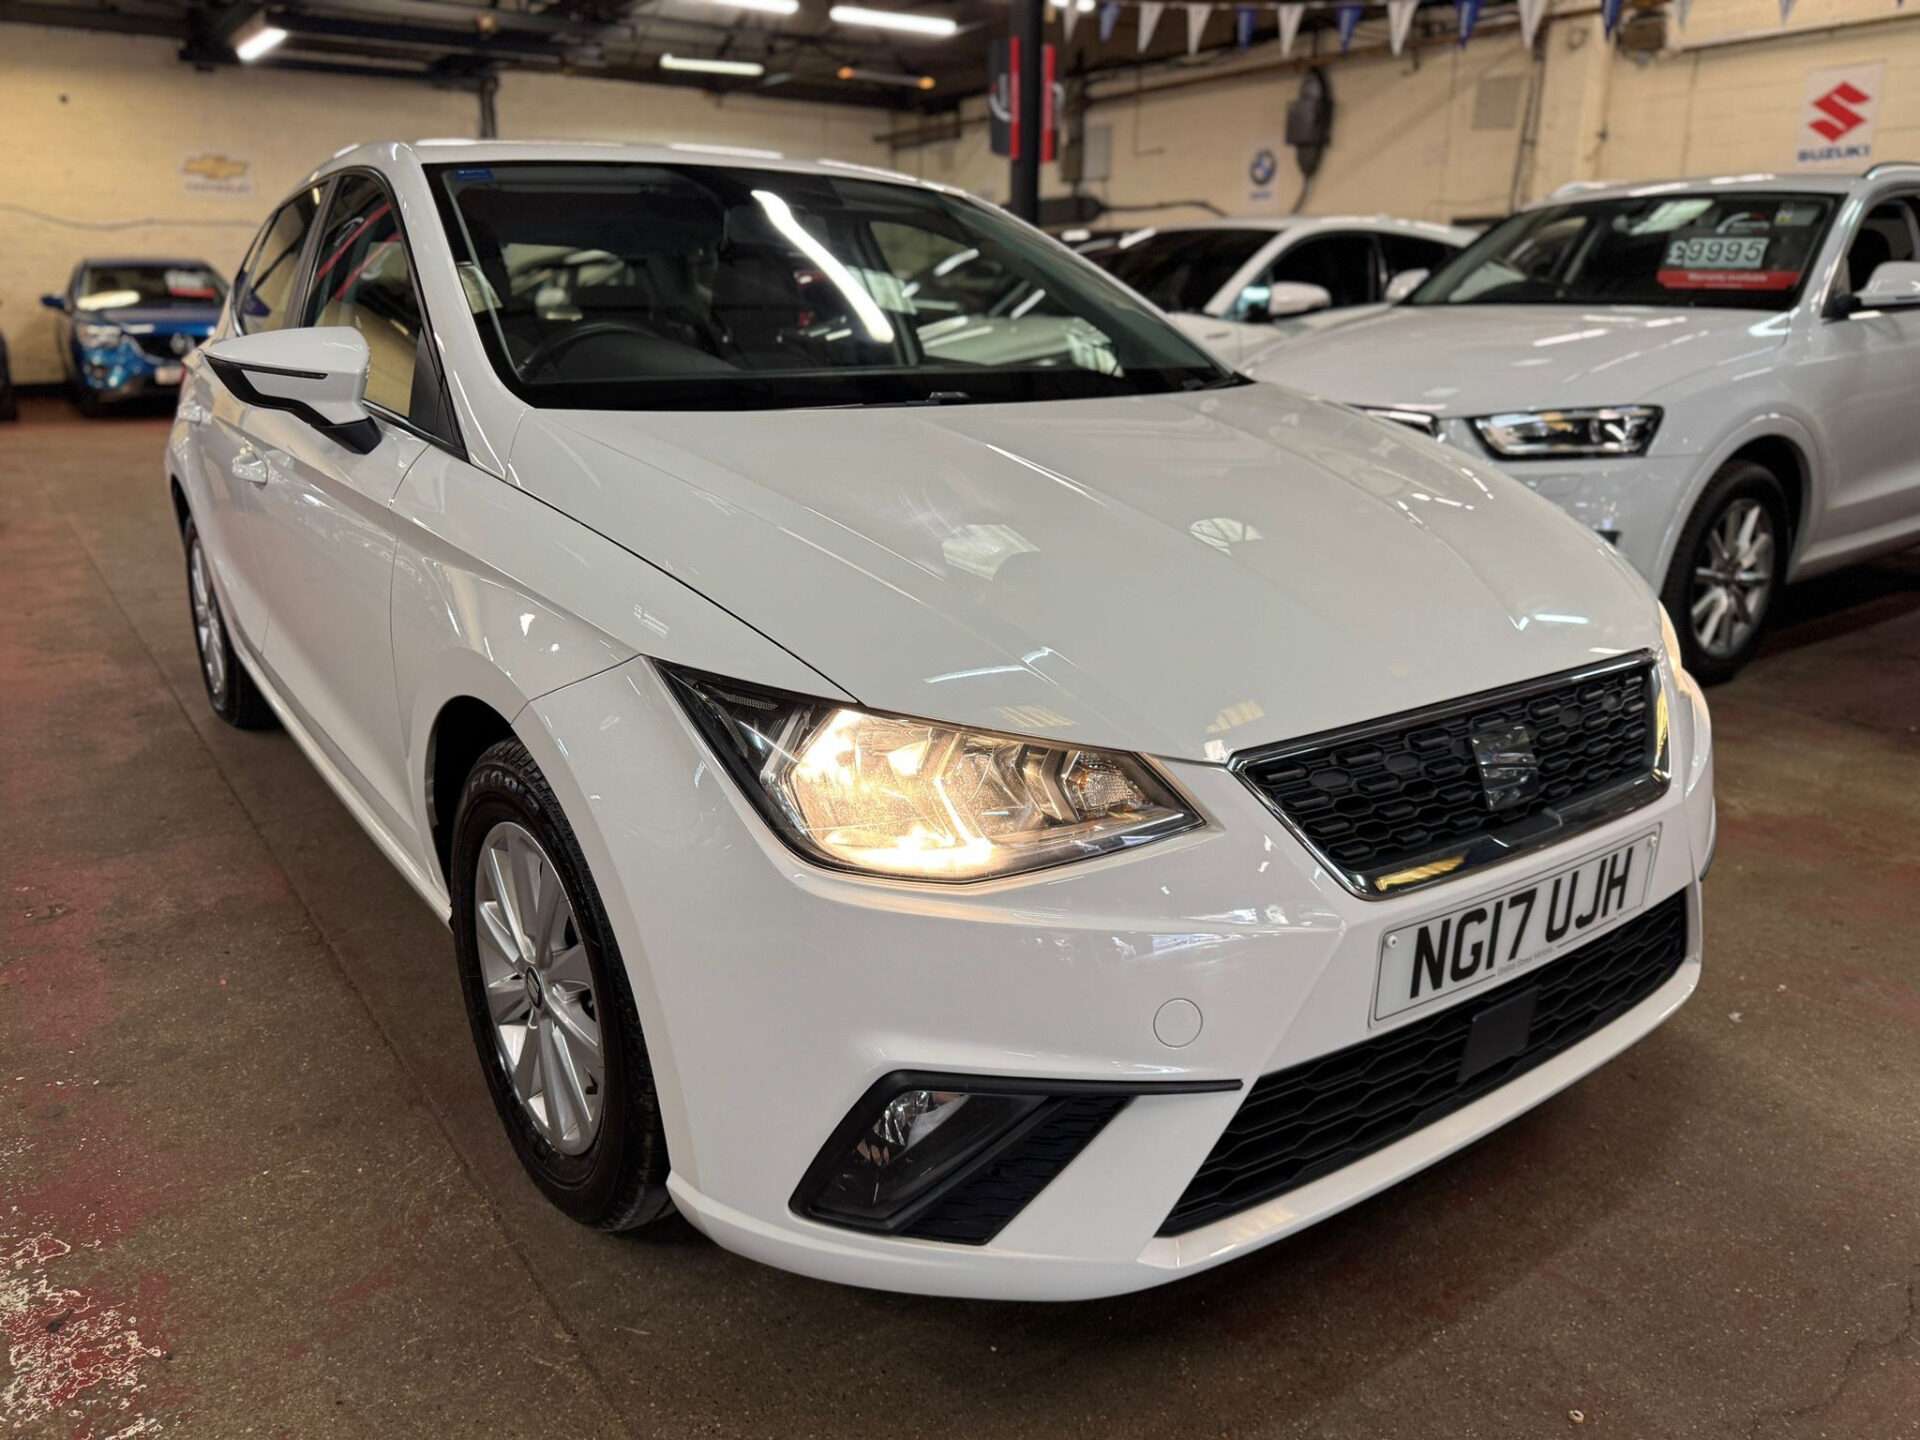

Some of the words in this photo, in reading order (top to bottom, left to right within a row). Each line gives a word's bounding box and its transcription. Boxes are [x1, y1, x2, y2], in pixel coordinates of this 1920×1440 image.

[1665, 239, 1764, 265] £9995
[1409, 888, 1537, 999] NG17
[1545, 847, 1634, 943] UJH
